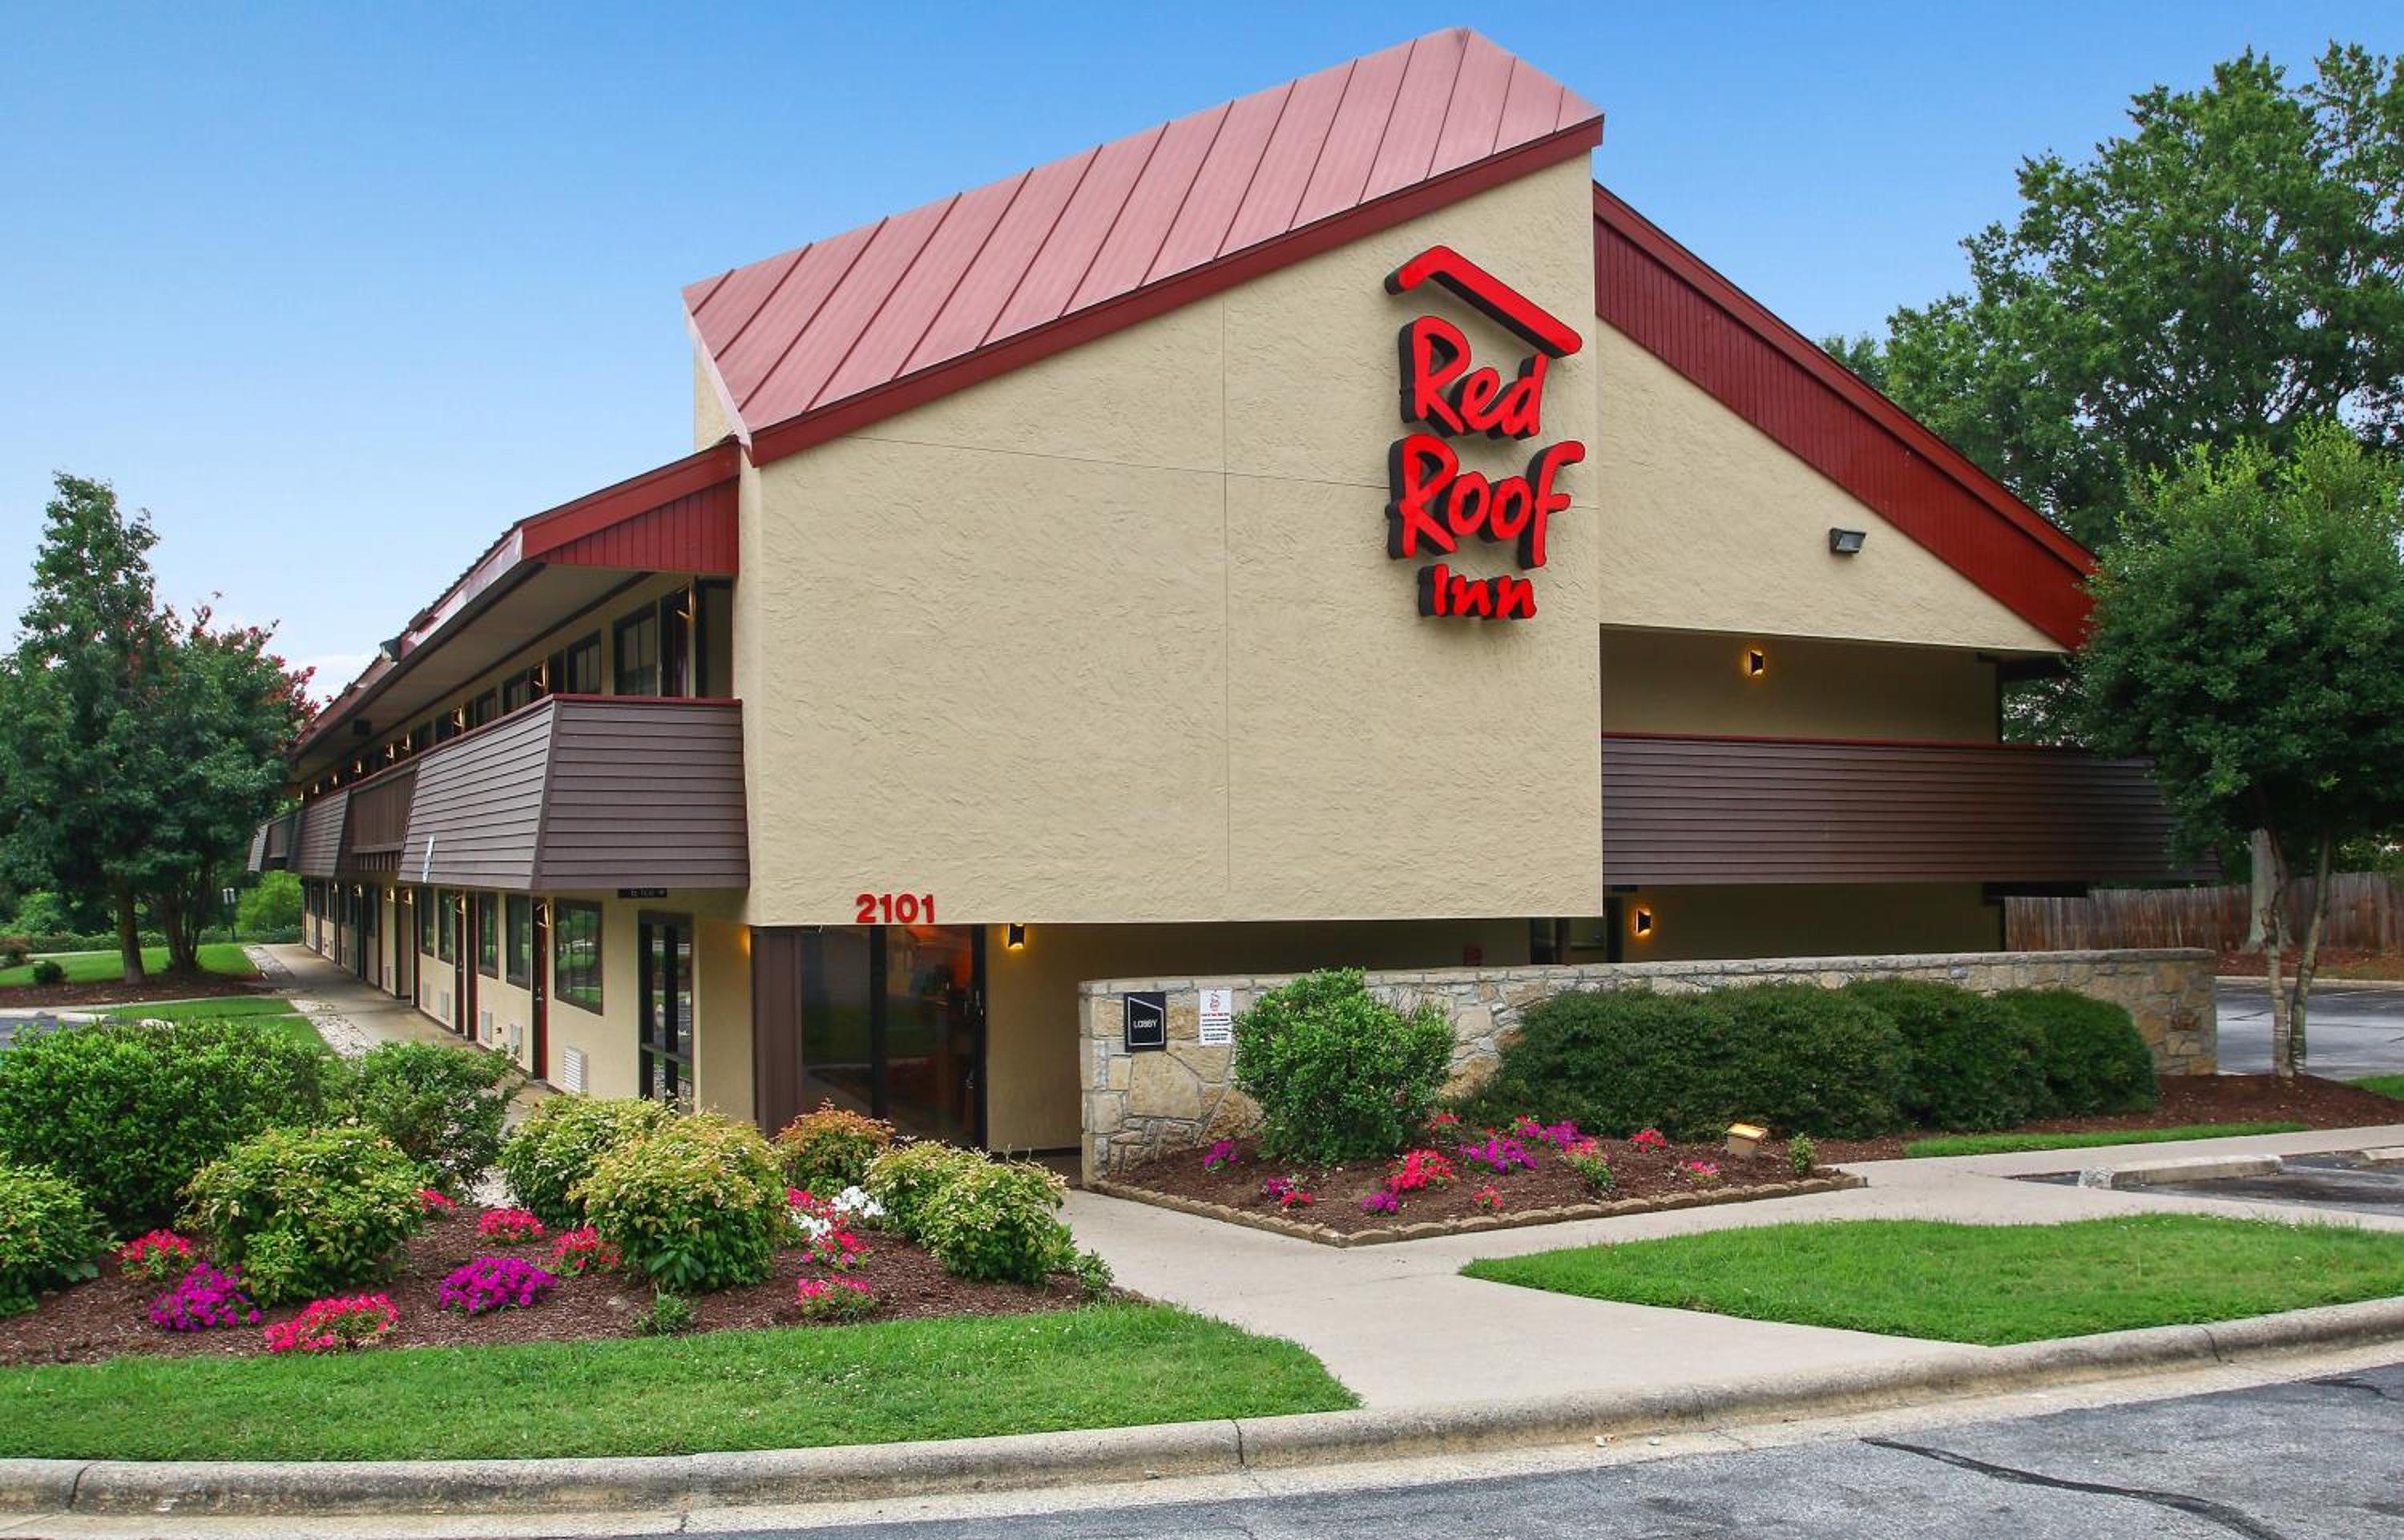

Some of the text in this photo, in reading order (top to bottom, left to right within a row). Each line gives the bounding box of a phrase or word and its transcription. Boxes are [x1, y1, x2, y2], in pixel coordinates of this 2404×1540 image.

[1410, 316, 1549, 436] Red
[1399, 433, 1586, 567] Roof
[1431, 563, 1537, 619] Inn
[855, 893, 935, 924] 2101
[1132, 1018, 1158, 1029] LOBBY
